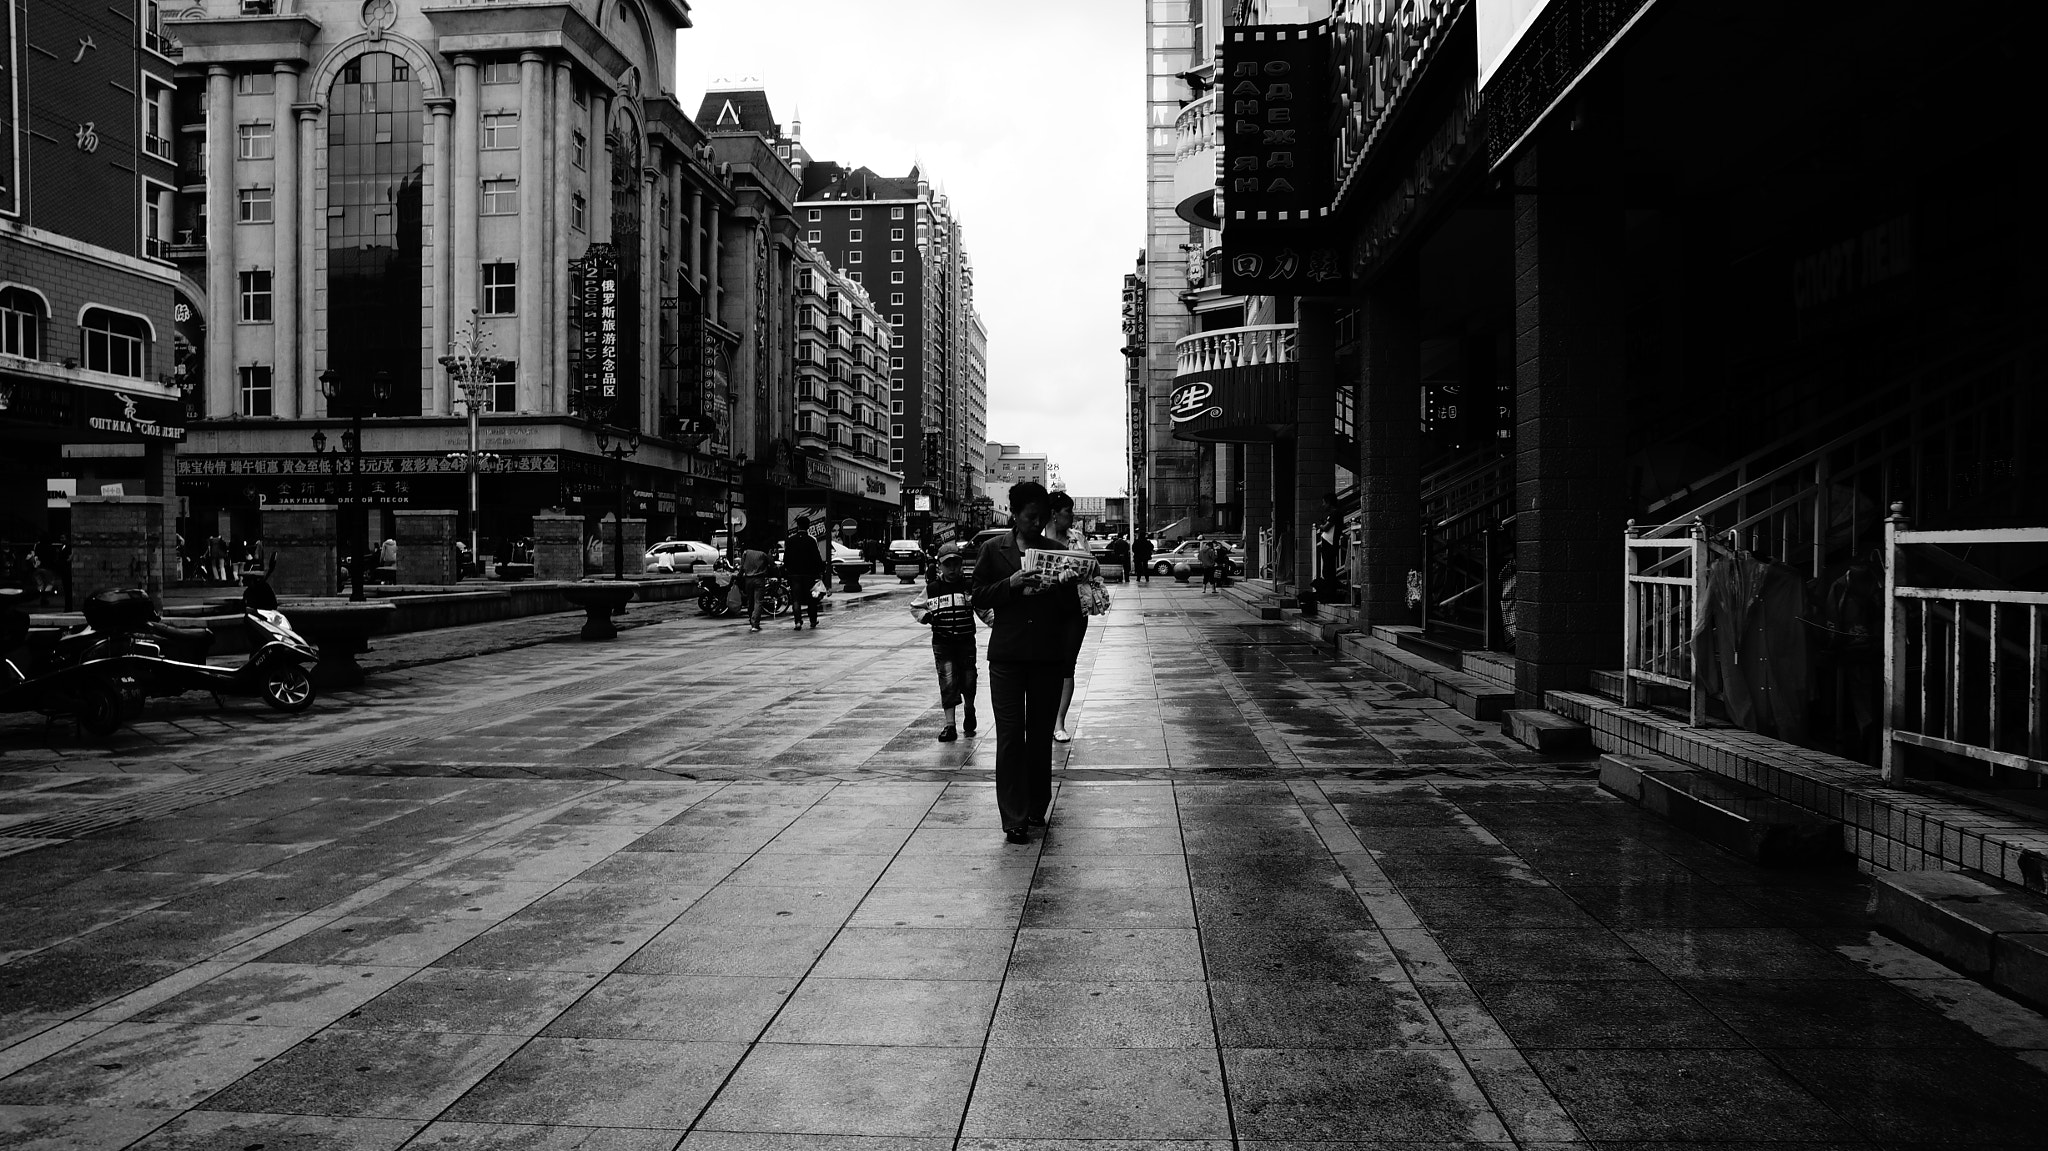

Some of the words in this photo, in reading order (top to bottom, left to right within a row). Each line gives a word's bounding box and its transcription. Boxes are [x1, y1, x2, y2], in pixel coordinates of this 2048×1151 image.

[1233, 61, 1260, 135] ЛАНЬ
[1263, 61, 1296, 192] ОДЕЖДА
[601, 279, 616, 397] 俄罗斯旅游纪念品区
[89, 417, 133, 433] ОПТИКА
